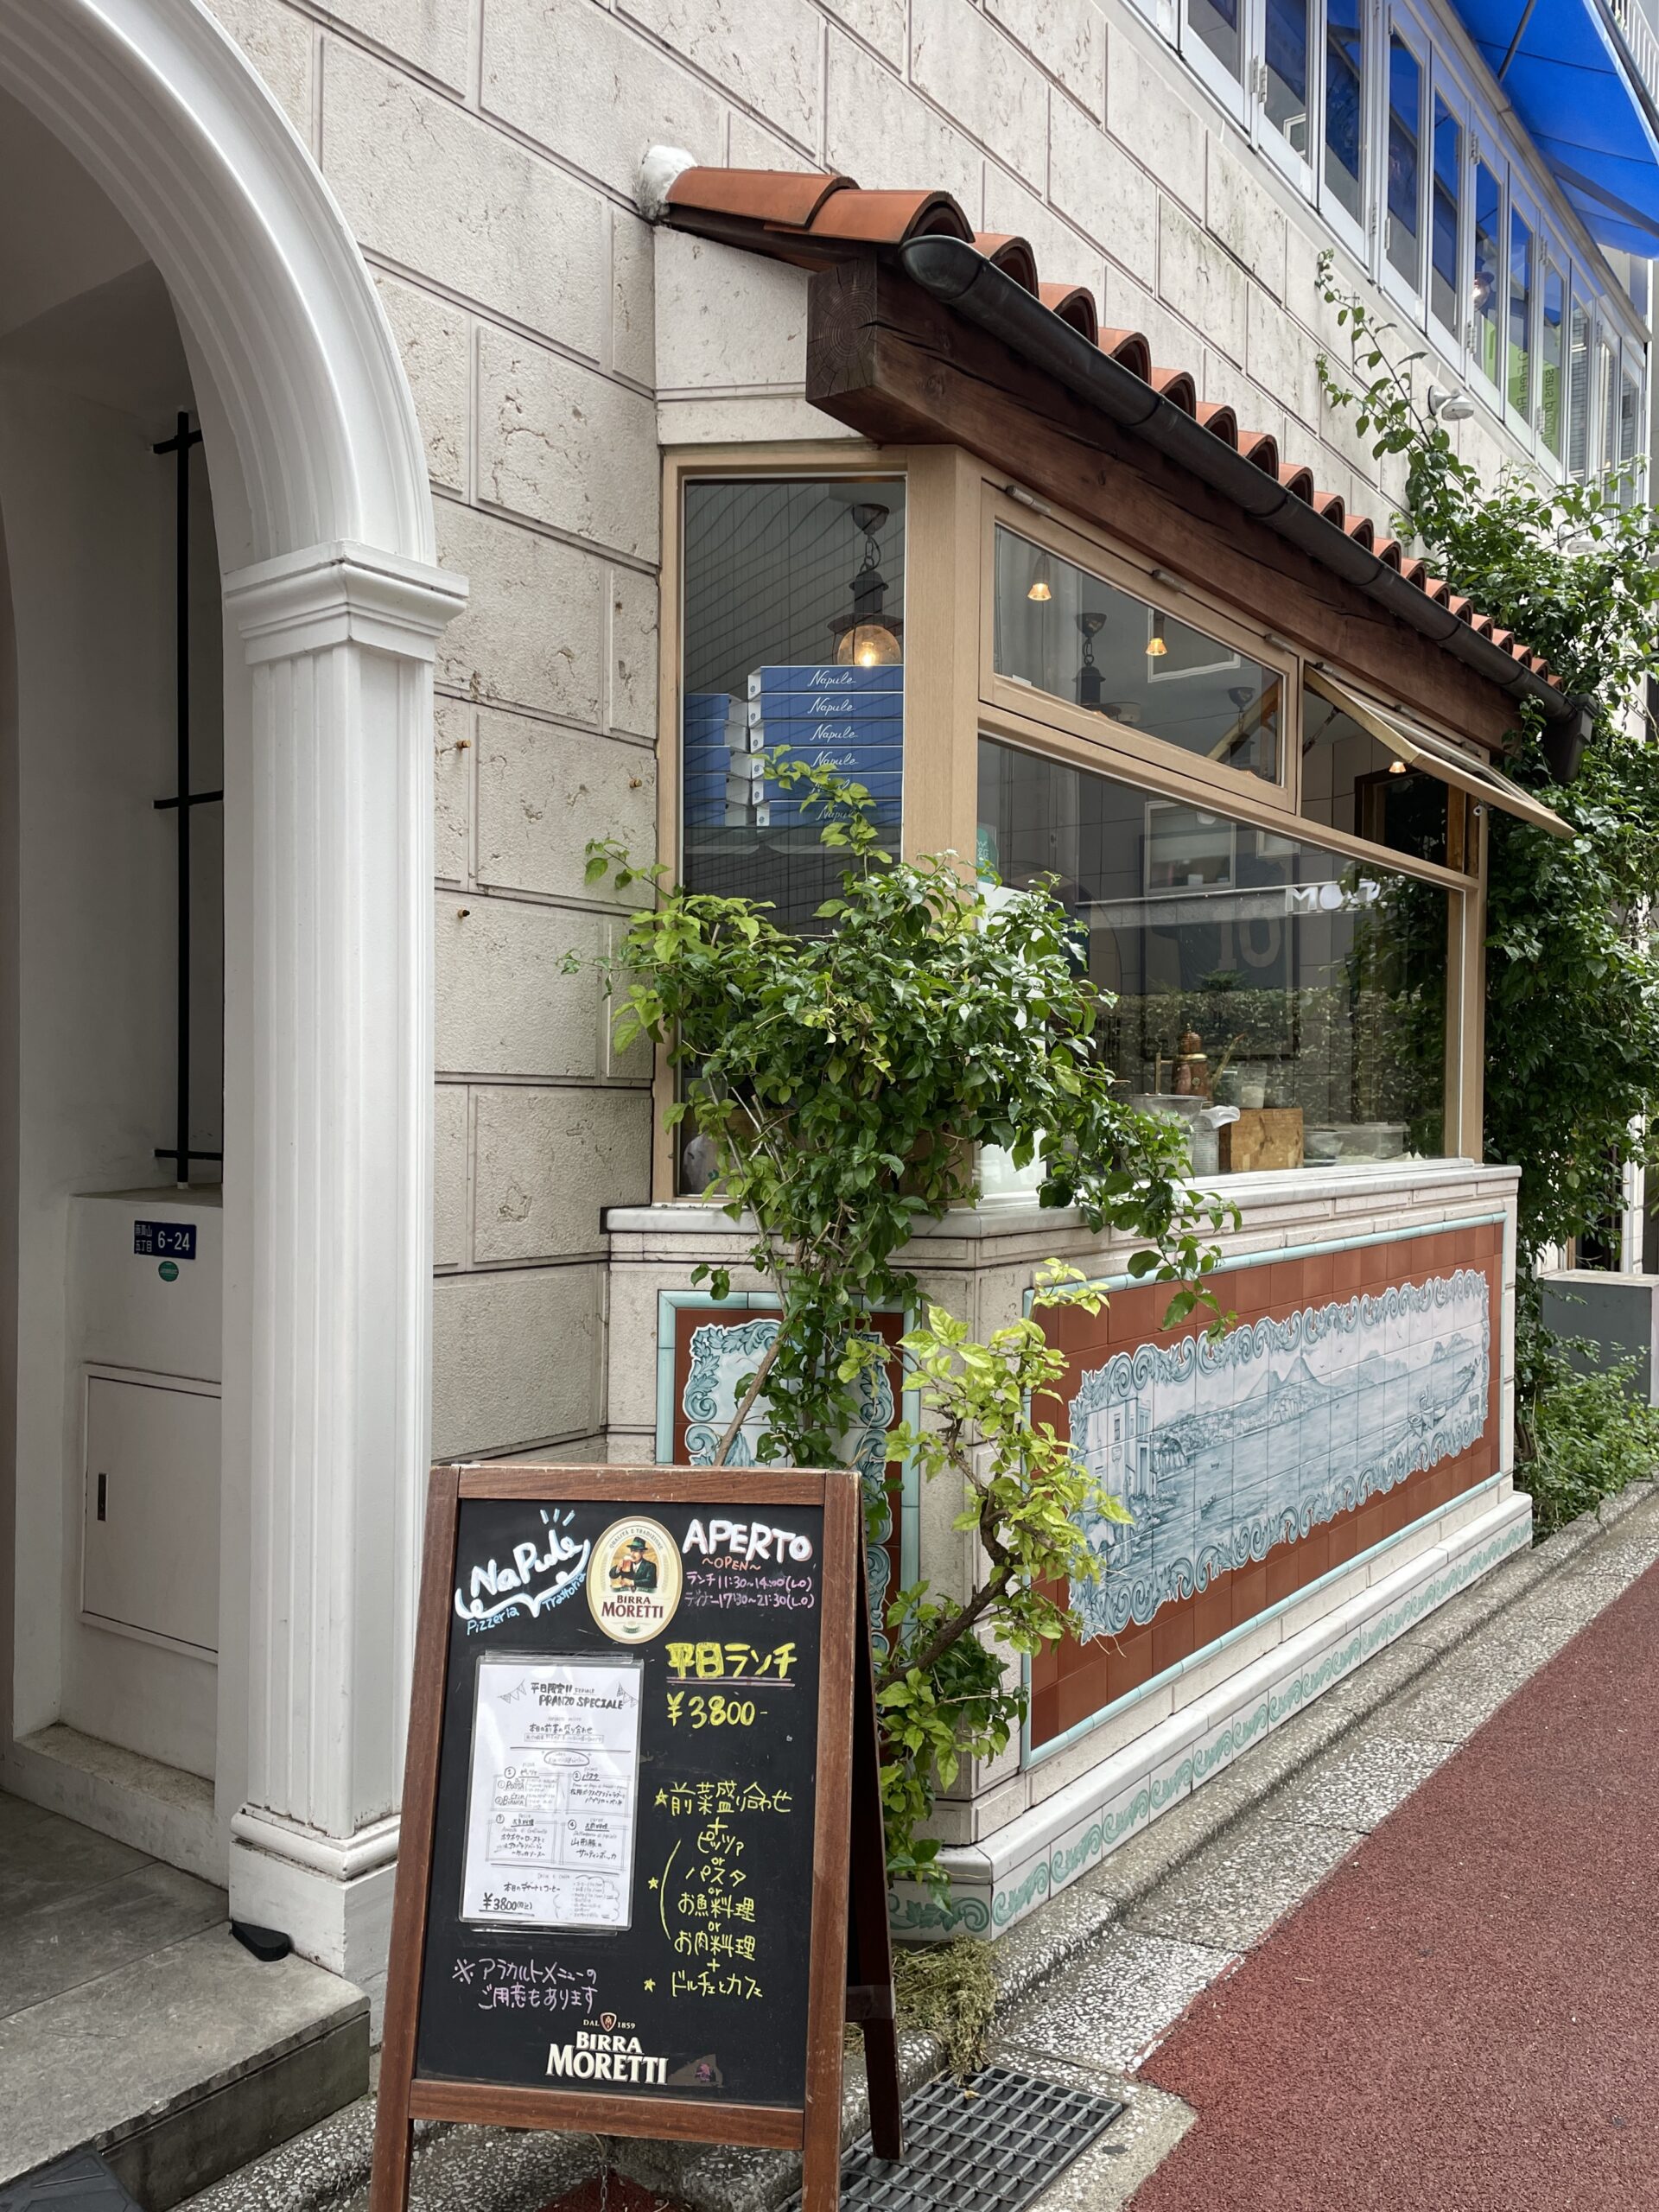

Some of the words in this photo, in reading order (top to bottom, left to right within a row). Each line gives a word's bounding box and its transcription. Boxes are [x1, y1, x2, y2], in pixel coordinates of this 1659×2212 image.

[807, 670, 856, 688] Napule
[807, 697, 856, 715] Napule
[810, 724, 858, 741] Napule
[157, 1230, 191, 1251] 6-24
[682, 1519, 814, 1564] APERTO
[541, 1572, 586, 1611] Trattoria
[617, 1595, 651, 1605] BIRRA
[601, 1602, 664, 1618] MORETTI
[467, 1606, 520, 1636] Pizzeria
[665, 1642, 798, 1680] 平日ランチ
[538, 1694, 575, 1707] PRANZO
[576, 1696, 624, 1709] SPECIALE
[710, 1857, 726, 1866] or
[685, 1866, 747, 1887] パスタ
[708, 1887, 722, 1896] or
[677, 1891, 756, 1923] お魚料理
[708, 1921, 721, 1932] or
[674, 1930, 756, 1961] お肉料理
[671, 1970, 763, 1999] ドルチェとカフェ
[478, 1981, 599, 2013] ご用意もあります
[575, 2031, 645, 2055] BIRRA
[545, 2044, 669, 2085] MORETTI
